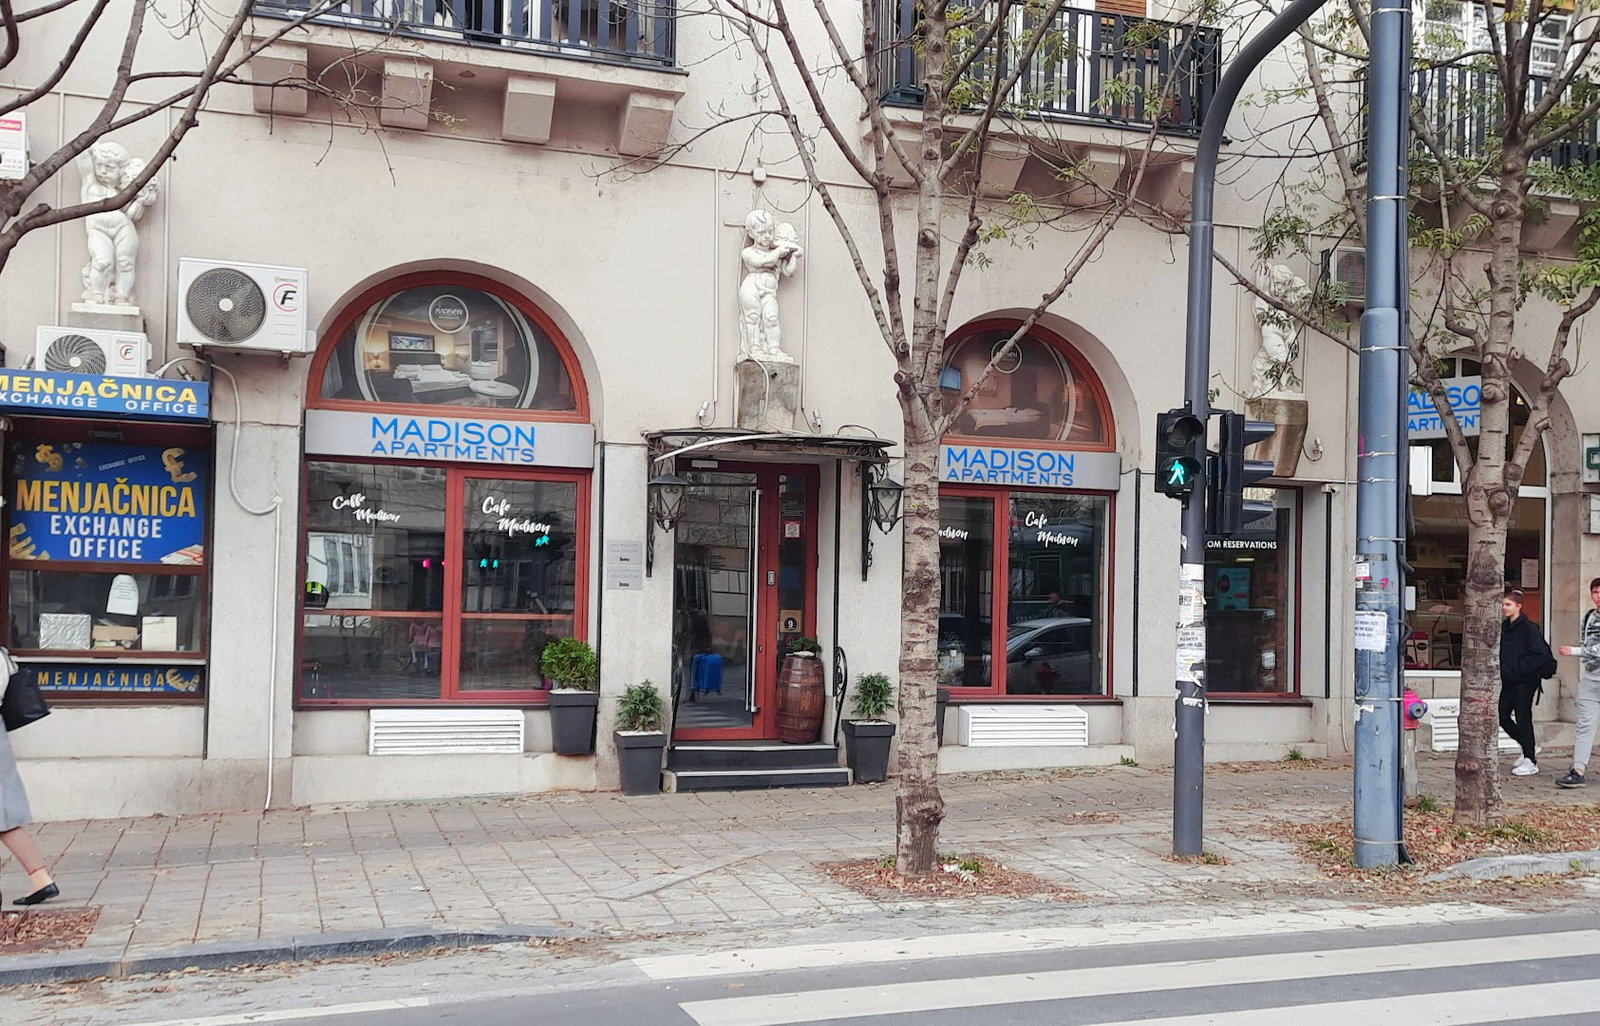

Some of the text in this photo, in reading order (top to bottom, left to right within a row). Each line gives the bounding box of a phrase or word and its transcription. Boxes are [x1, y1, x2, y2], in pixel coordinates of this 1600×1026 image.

[125, 400, 198, 414] OFFICE
[371, 416, 536, 448] MADISON
[371, 440, 536, 463] APARTMENTS
[946, 447, 1075, 473] MADISON
[946, 468, 1074, 487] APARTMENTS
[16, 477, 197, 518] MENJAČNICA
[332, 493, 367, 510] Caffe
[482, 496, 511, 516] Cafe
[352, 508, 401, 524] Madison
[1025, 511, 1048, 529] Cafe
[51, 514, 163, 539] EXCHANGE
[496, 518, 551, 538] Madison
[938, 526, 969, 541] adison
[69, 537, 143, 560] OFFICE
[1036, 531, 1079, 548] Madison
[1222, 540, 1278, 550] RESERVATIONS
